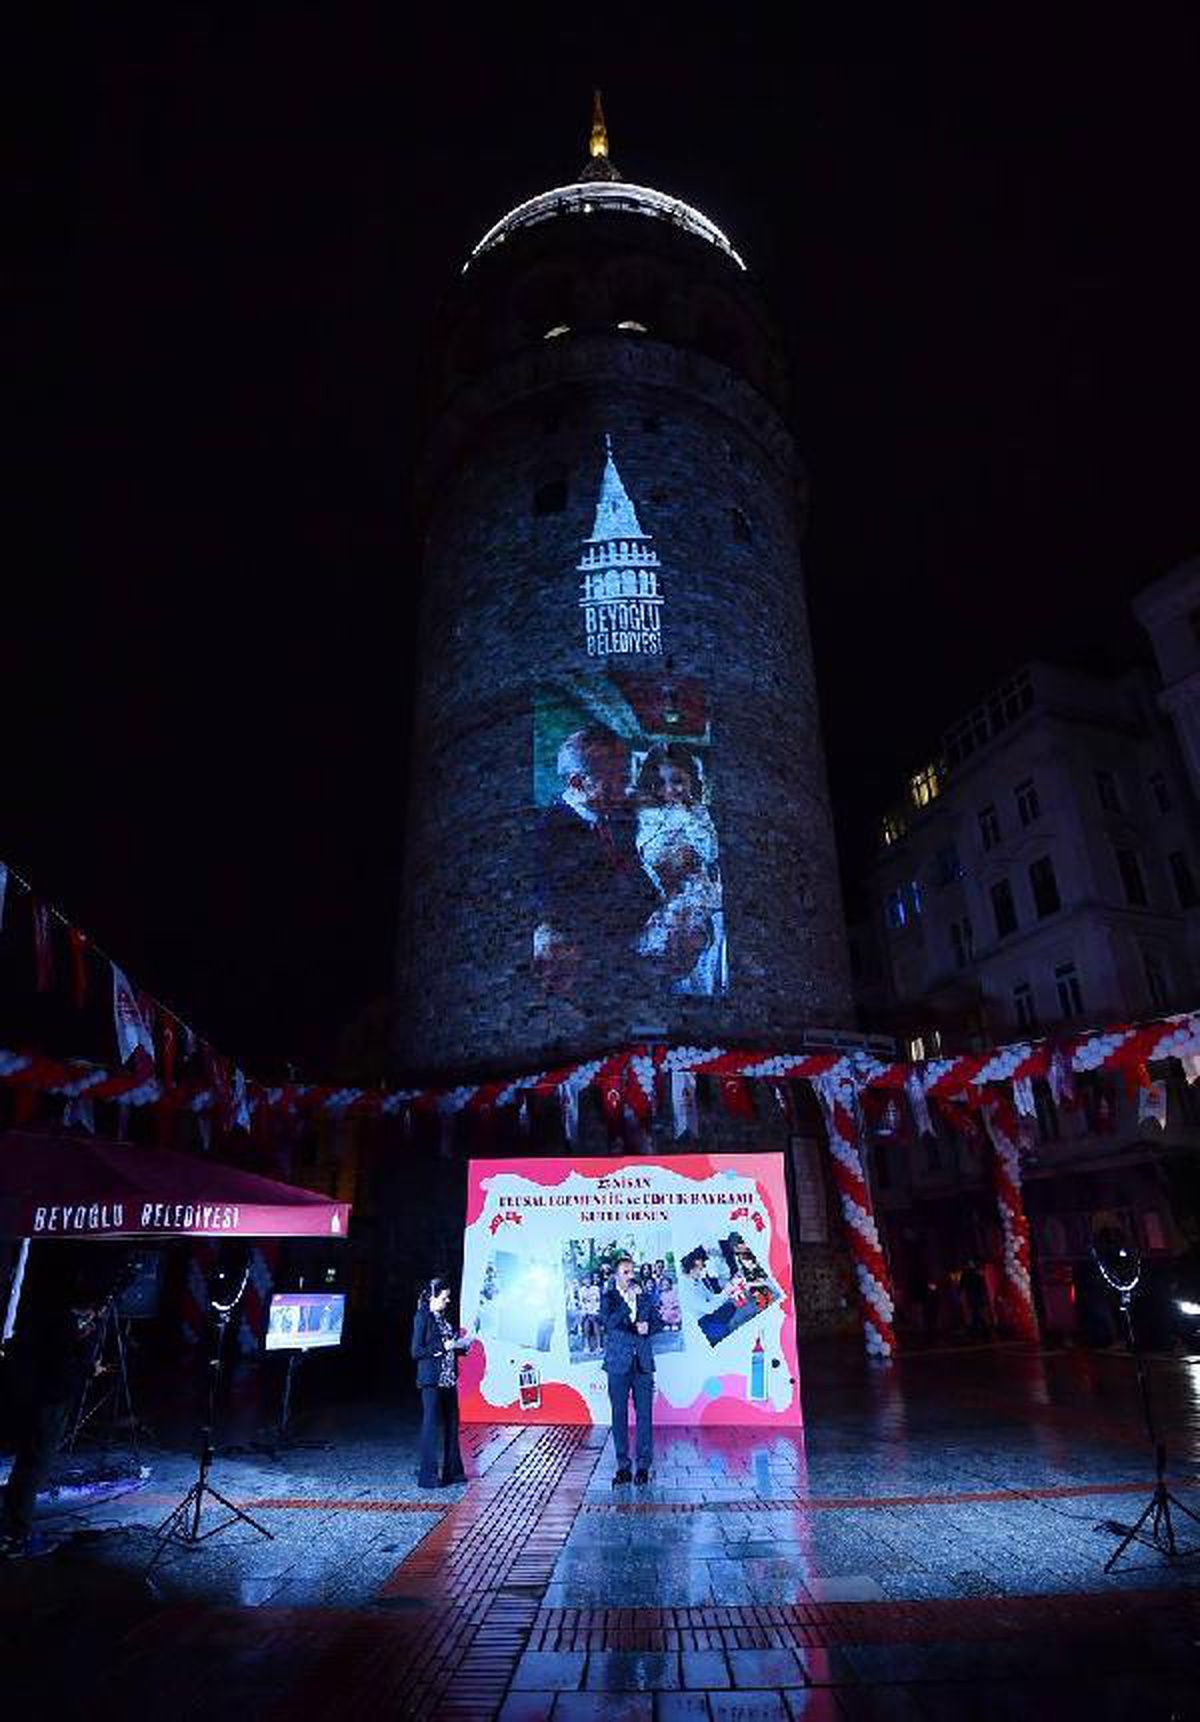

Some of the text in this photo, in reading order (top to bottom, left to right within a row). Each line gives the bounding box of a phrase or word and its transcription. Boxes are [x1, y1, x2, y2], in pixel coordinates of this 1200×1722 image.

[585, 603, 661, 632] BEYOĞLU
[612, 1176, 651, 1189] NİSAN
[499, 1195, 546, 1207] ULUSAL
[691, 1193, 753, 1205] BAYRAMI
[34, 1203, 123, 1231] BEYOĞLU
